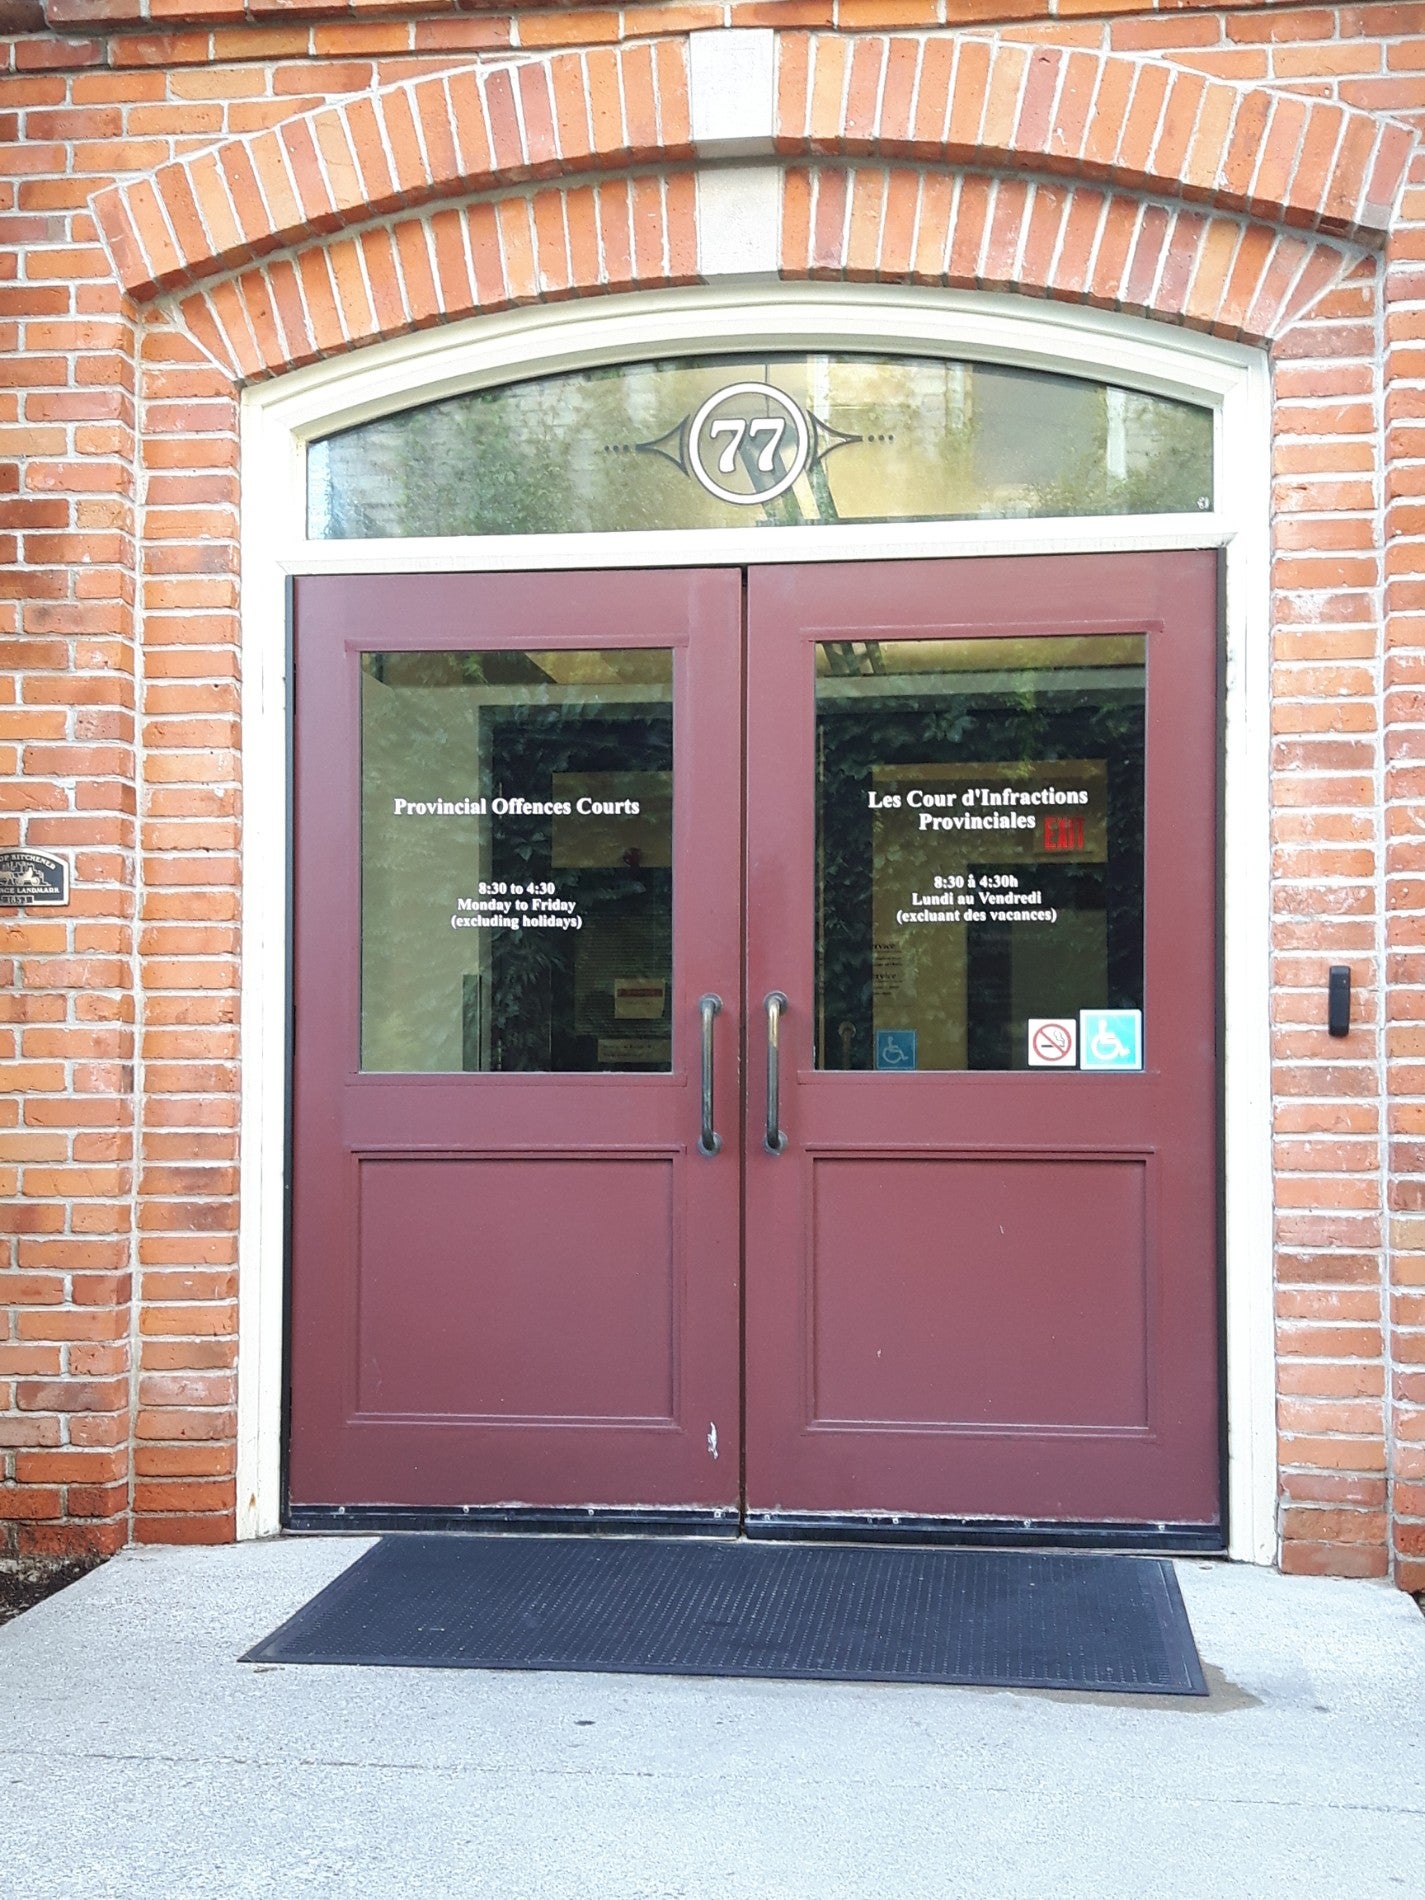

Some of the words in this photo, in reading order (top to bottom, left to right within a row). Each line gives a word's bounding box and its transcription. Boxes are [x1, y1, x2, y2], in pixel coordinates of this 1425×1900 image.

[708, 416, 787, 474] 77
[393, 797, 487, 815] Provincial
[492, 797, 572, 815] Offences
[576, 797, 640, 815] Courts
[867, 791, 902, 809] Les
[906, 790, 957, 808] Cour
[961, 786, 1089, 807] d'Infractions
[918, 811, 1036, 831] Provinciales
[1043, 816, 1085, 850] EXIT
[478, 882, 507, 895] 8:30
[510, 883, 524, 895] to
[526, 882, 556, 895] 4:30
[933, 876, 965, 889] 8:30
[979, 874, 1019, 889] 4:30h
[457, 898, 512, 914] Monday
[515, 899, 529, 911] to
[532, 898, 576, 914] Friday
[911, 892, 954, 906] Lundi
[957, 894, 975, 905] au
[978, 890, 1042, 905] Vendredi
[450, 911, 520, 930] (excluding
[522, 911, 583, 930] holidays)
[896, 908, 961, 925] (excluant
[963, 908, 987, 922] des
[989, 907, 1058, 923] vacances)
